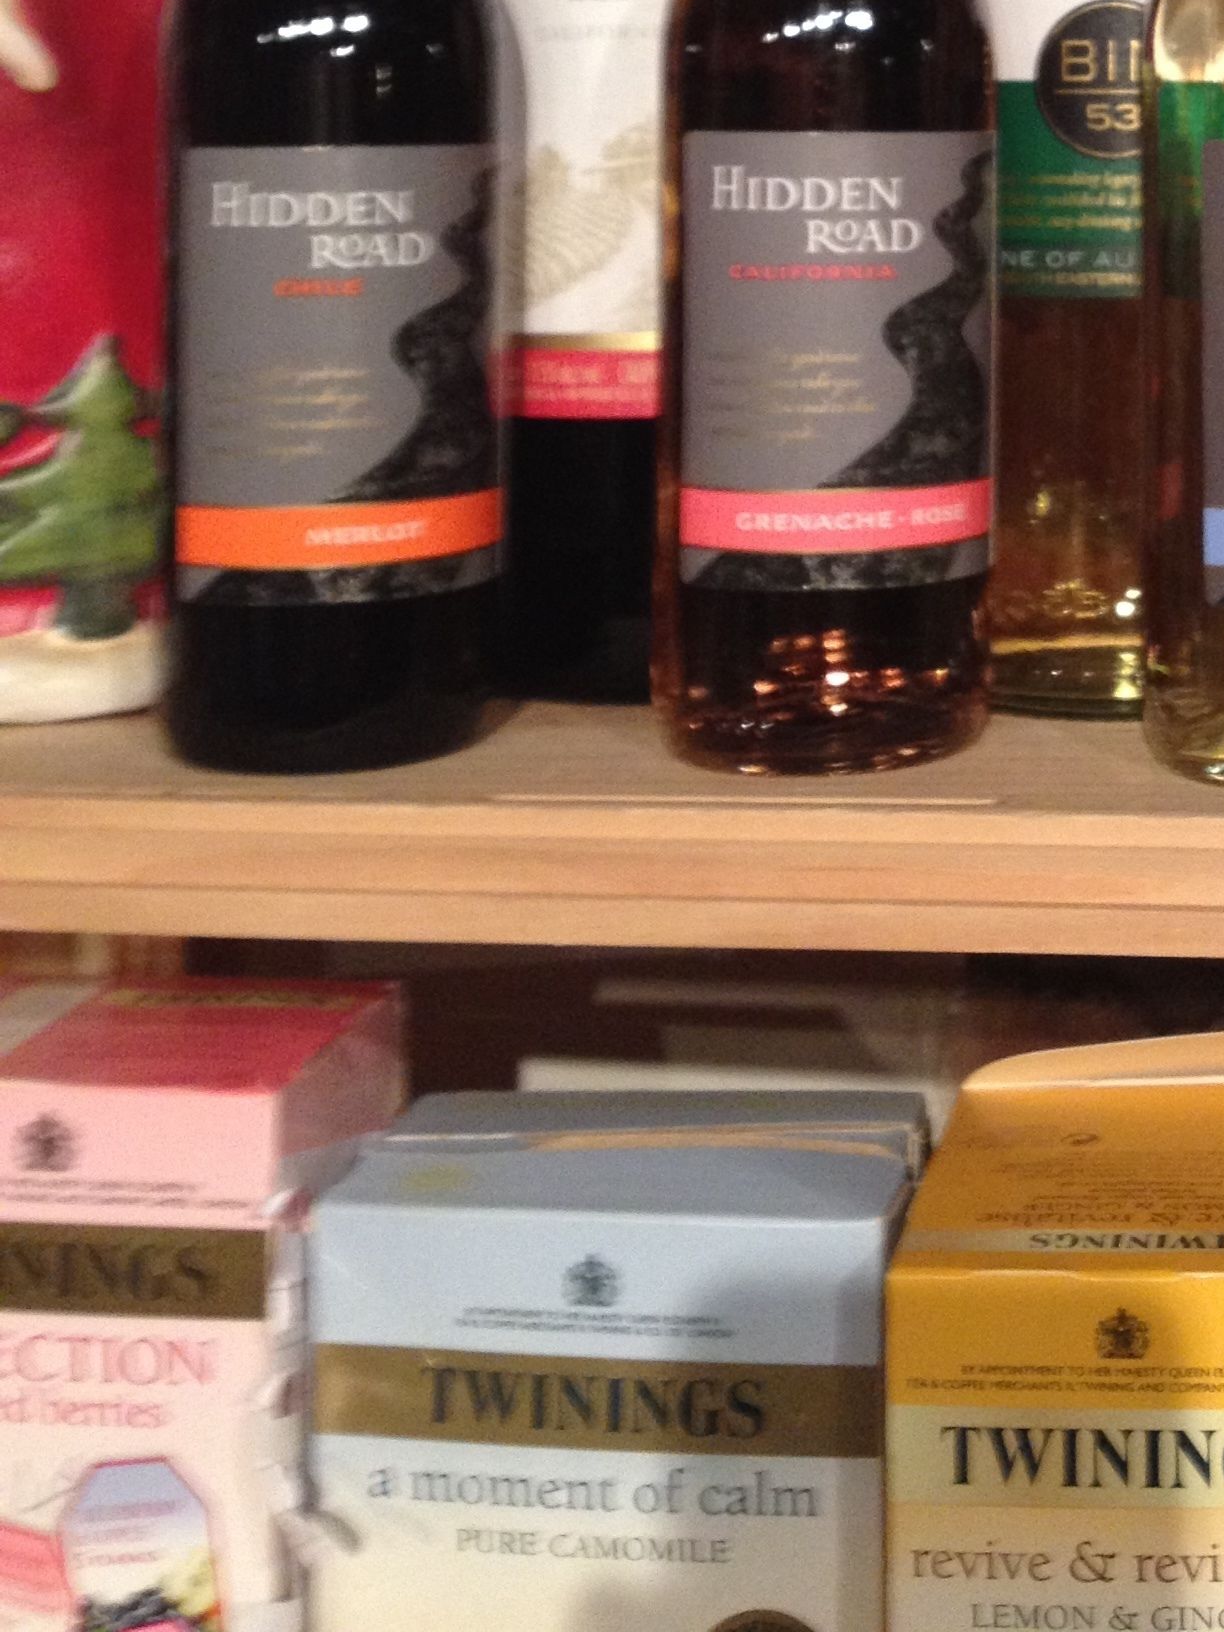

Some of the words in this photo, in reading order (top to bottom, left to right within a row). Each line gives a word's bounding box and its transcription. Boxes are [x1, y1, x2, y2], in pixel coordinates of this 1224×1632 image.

[1086, 103, 1142, 132] 53
[210, 182, 416, 228] HIDDEN
[711, 165, 903, 212] HIDDEN
[310, 232, 436, 269] ROAD
[805, 218, 926, 255] ROAD
[728, 263, 898, 282] CALIFORNIA
[1045, 249, 1087, 269] OF
[735, 510, 894, 533] GRENACHE
[1169, 1368, 1210, 1379] QUEEN
[422, 1366, 767, 1439] TWININGS
[367, 1469, 391, 1499] a
[409, 1470, 622, 1514] moment
[632, 1468, 685, 1515] of
[696, 1470, 820, 1518] calm
[456, 1528, 541, 1558] PURE
[548, 1531, 733, 1565] CAMOMILE
[910, 1539, 1052, 1582] revive
[1068, 1541, 1116, 1584] &
[970, 1606, 1097, 1631] LEMON
[1107, 1606, 1139, 1631] &
